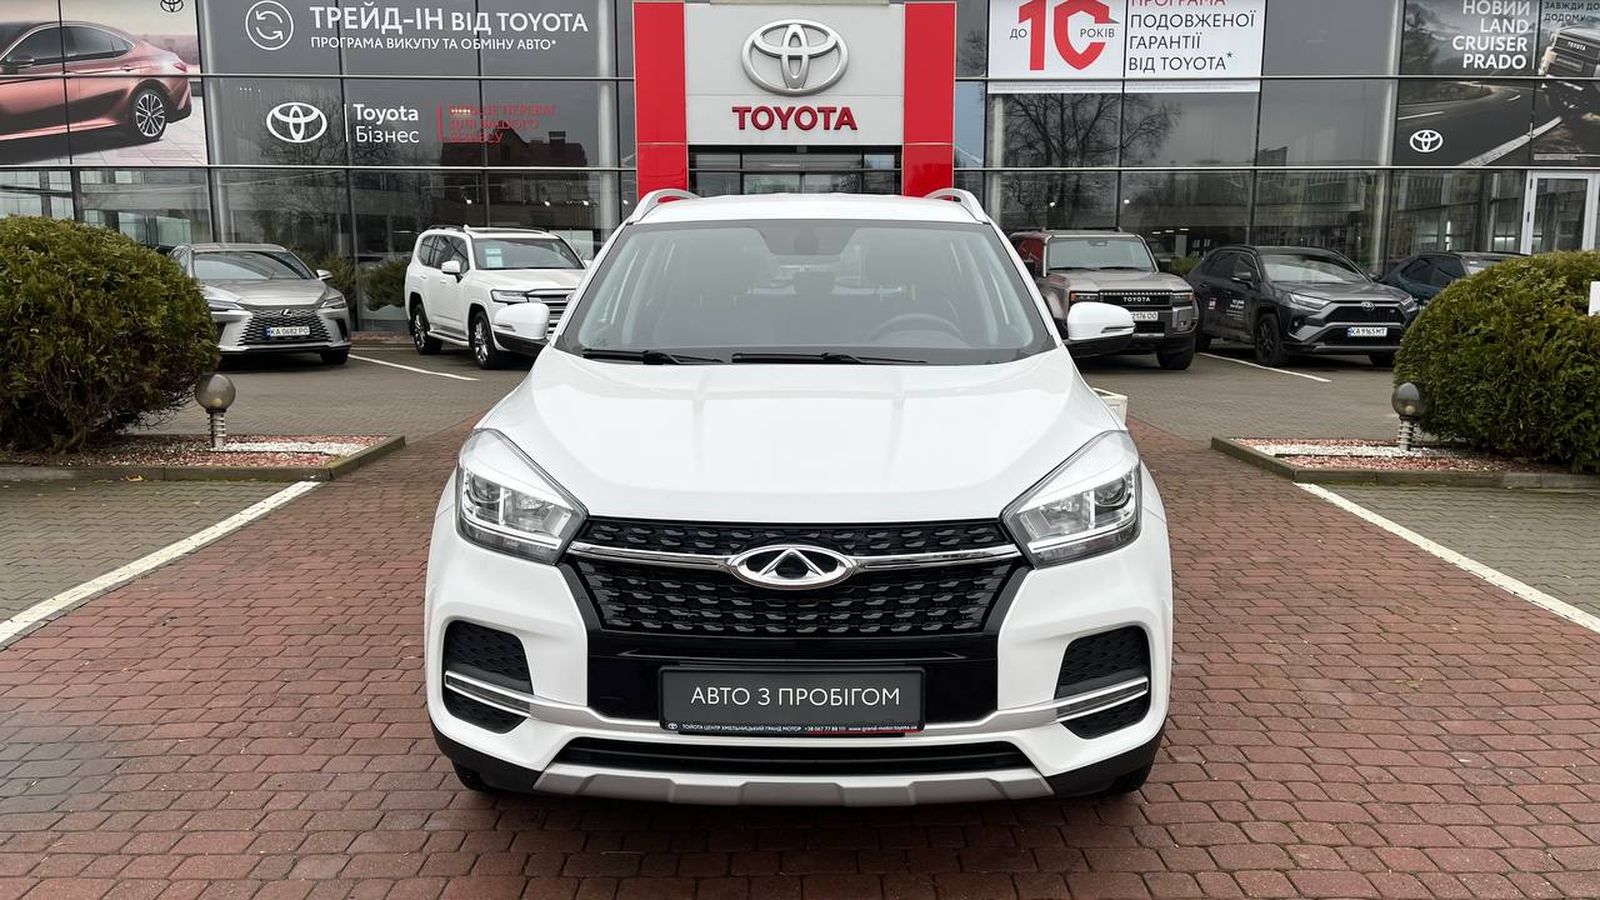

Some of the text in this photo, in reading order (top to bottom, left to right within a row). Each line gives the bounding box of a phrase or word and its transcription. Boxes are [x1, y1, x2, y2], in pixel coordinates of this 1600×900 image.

[309, 1, 588, 35] ТРЕЙД-ІН ВІД TOYOTA
[1130, 10, 1256, 31] ПОДОВЖЕНОЇ
[1480, 18, 1529, 33] LAND
[1010, 28, 1027, 39] ДО
[1080, 28, 1115, 38] РОКІВ
[1129, 32, 1202, 49] ГАРАНТІЇ
[311, 37, 383, 48] ПРОГРАМА
[386, 38, 440, 49] ВИКУПУ
[442, 39, 459, 49] ТА
[461, 38, 514, 50] ОБМІНУ
[1452, 35, 1528, 52] CRUISER
[1128, 57, 1156, 73] ВІД
[1463, 53, 1527, 69] PRADO
[353, 103, 419, 125] Toyota
[732, 105, 858, 131] TOYOTA
[356, 125, 420, 143] Бізнес
[690, 686, 750, 706] АВТО
[778, 687, 900, 706] ПРОБІГОМ
